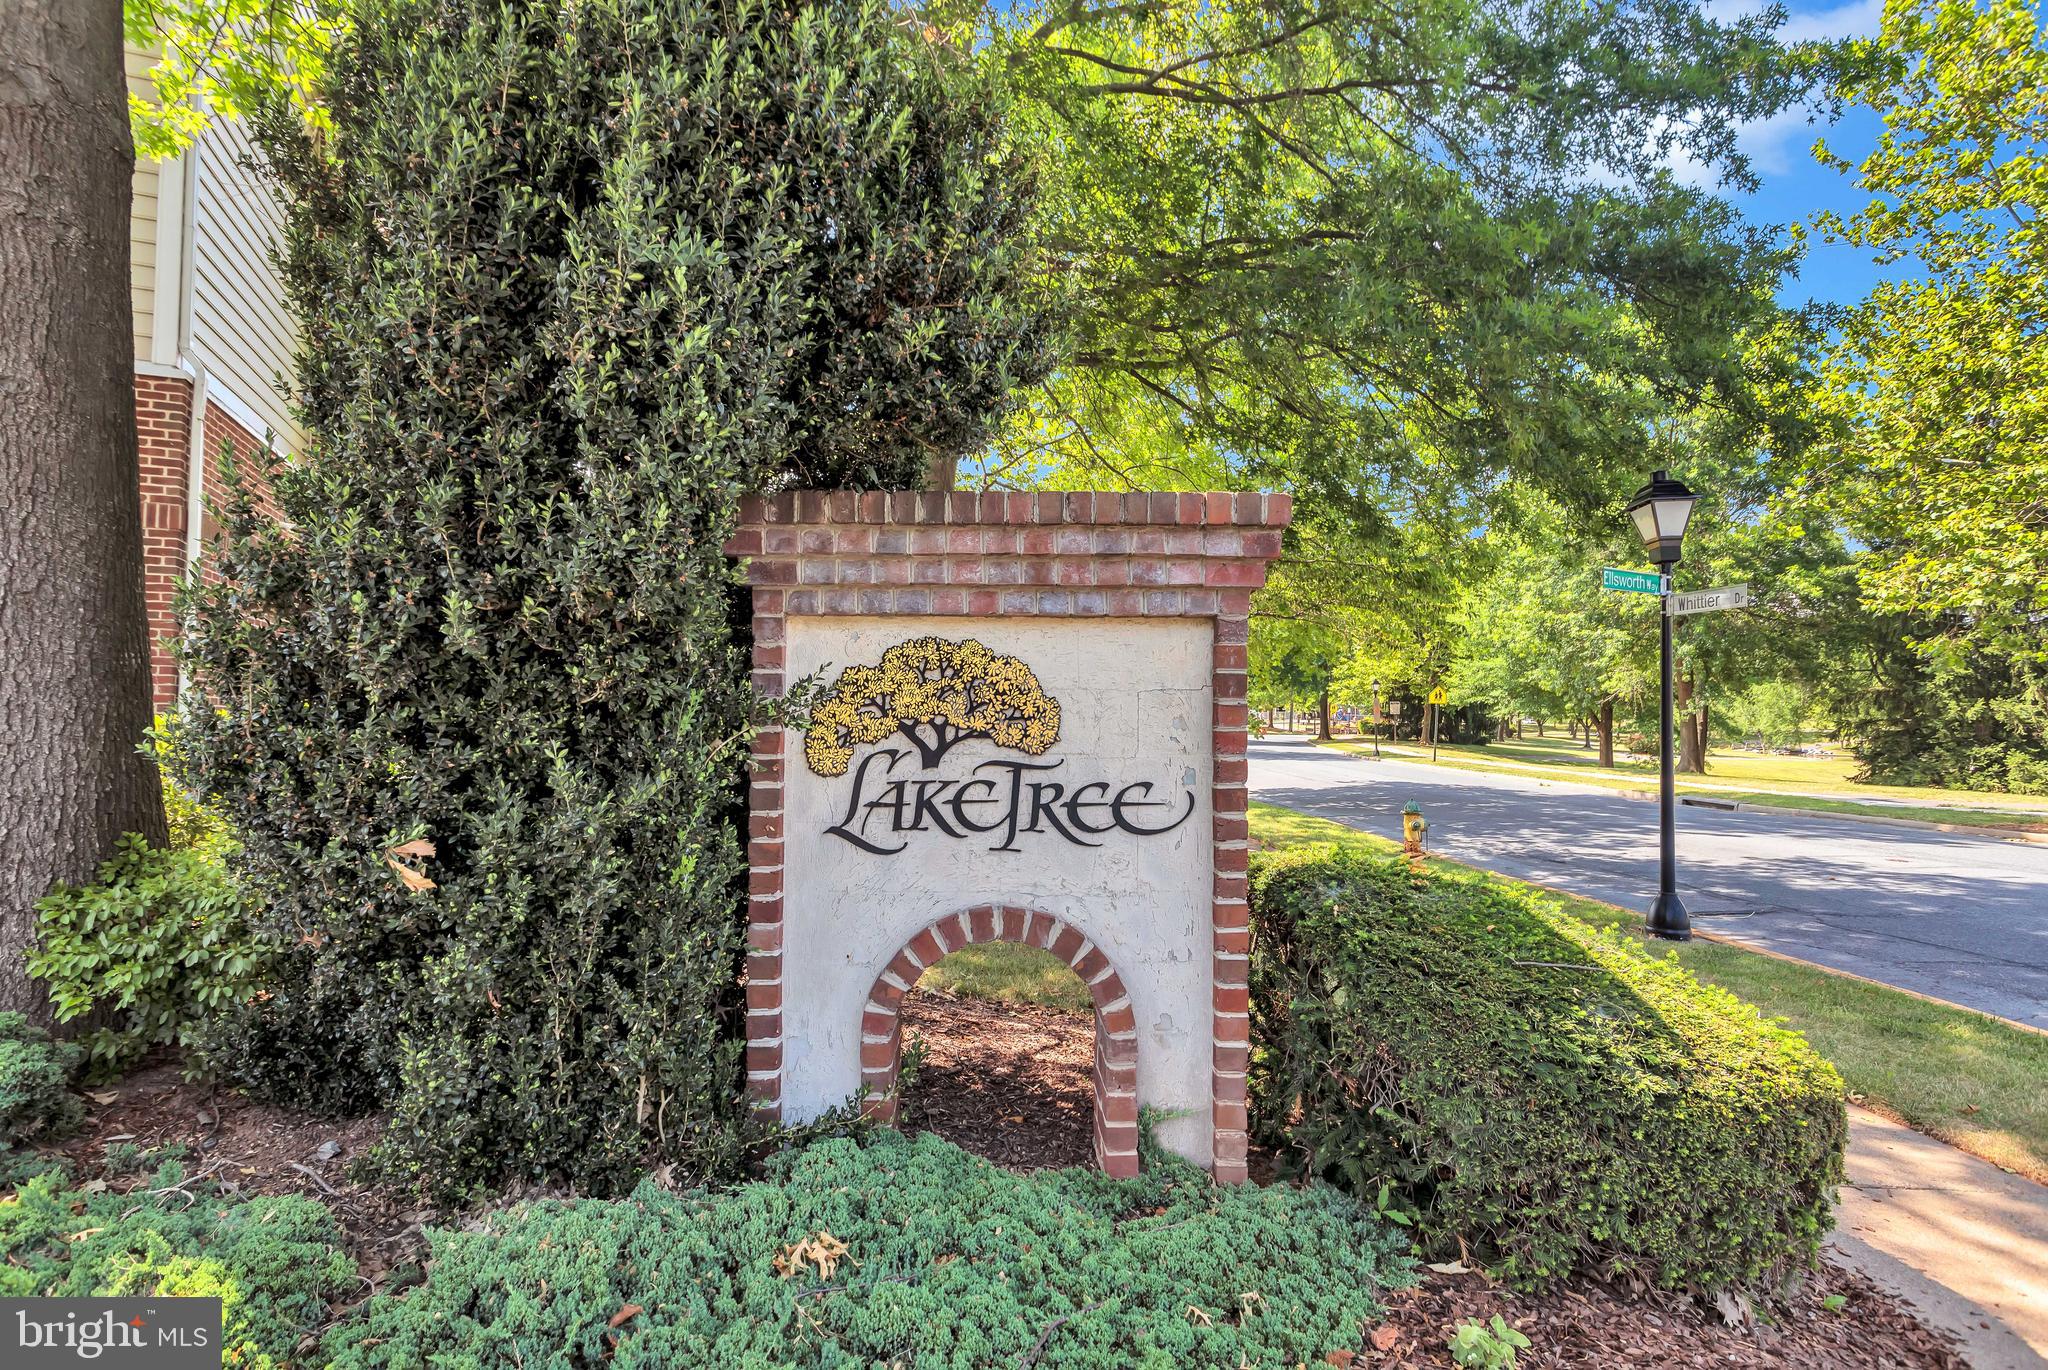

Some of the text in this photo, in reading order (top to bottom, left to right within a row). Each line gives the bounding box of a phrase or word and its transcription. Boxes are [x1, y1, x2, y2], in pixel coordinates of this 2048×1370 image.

[1603, 571, 1659, 592] Ellsworth Way
[1678, 592, 1744, 611] Whittier Dr
